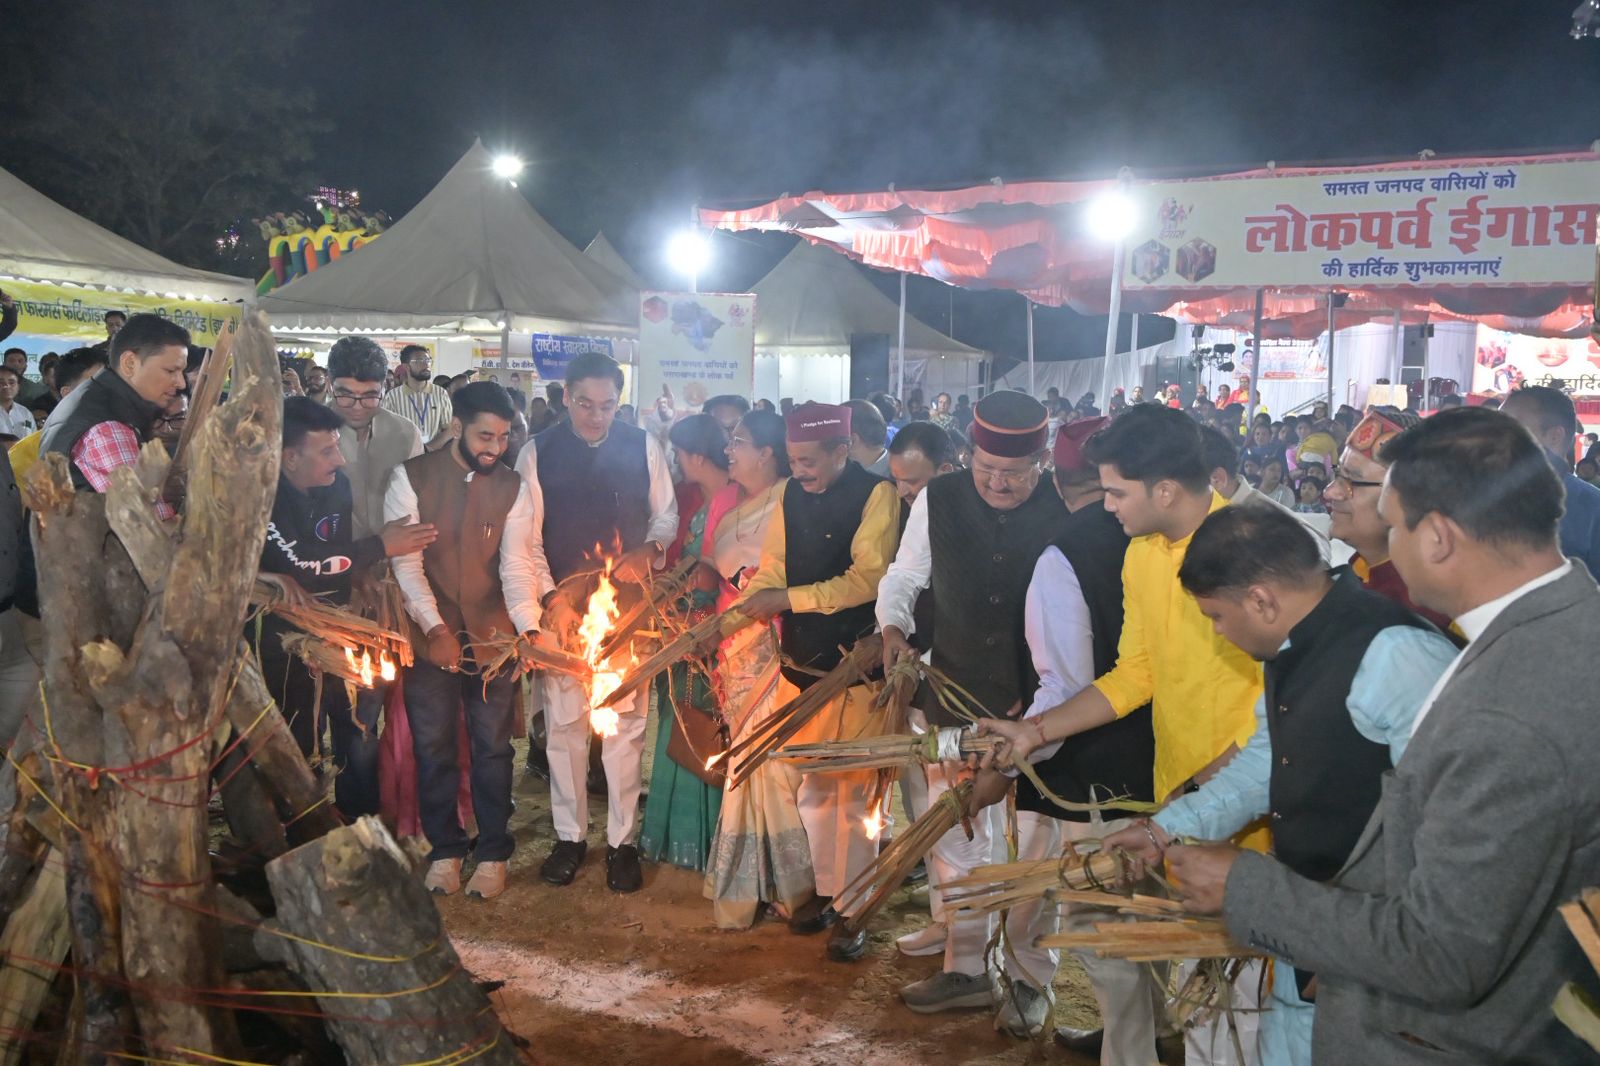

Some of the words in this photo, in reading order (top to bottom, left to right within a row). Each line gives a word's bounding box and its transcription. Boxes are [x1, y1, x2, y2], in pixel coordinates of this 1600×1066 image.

[1324, 180, 1369, 196] समस्त
[1374, 178, 1424, 193] जनपद
[1430, 171, 1489, 191] वासियों
[1493, 170, 1516, 189] को
[1245, 195, 1437, 253] लोकपर्व
[1448, 195, 1600, 254] ईगास
[1321, 258, 1342, 277] की
[1348, 256, 1398, 278] हार्दिक
[1404, 257, 1502, 282] शुभकामनाएं
[1562, 374, 1600, 391] हार्दि
[266, 521, 352, 576] Champio
